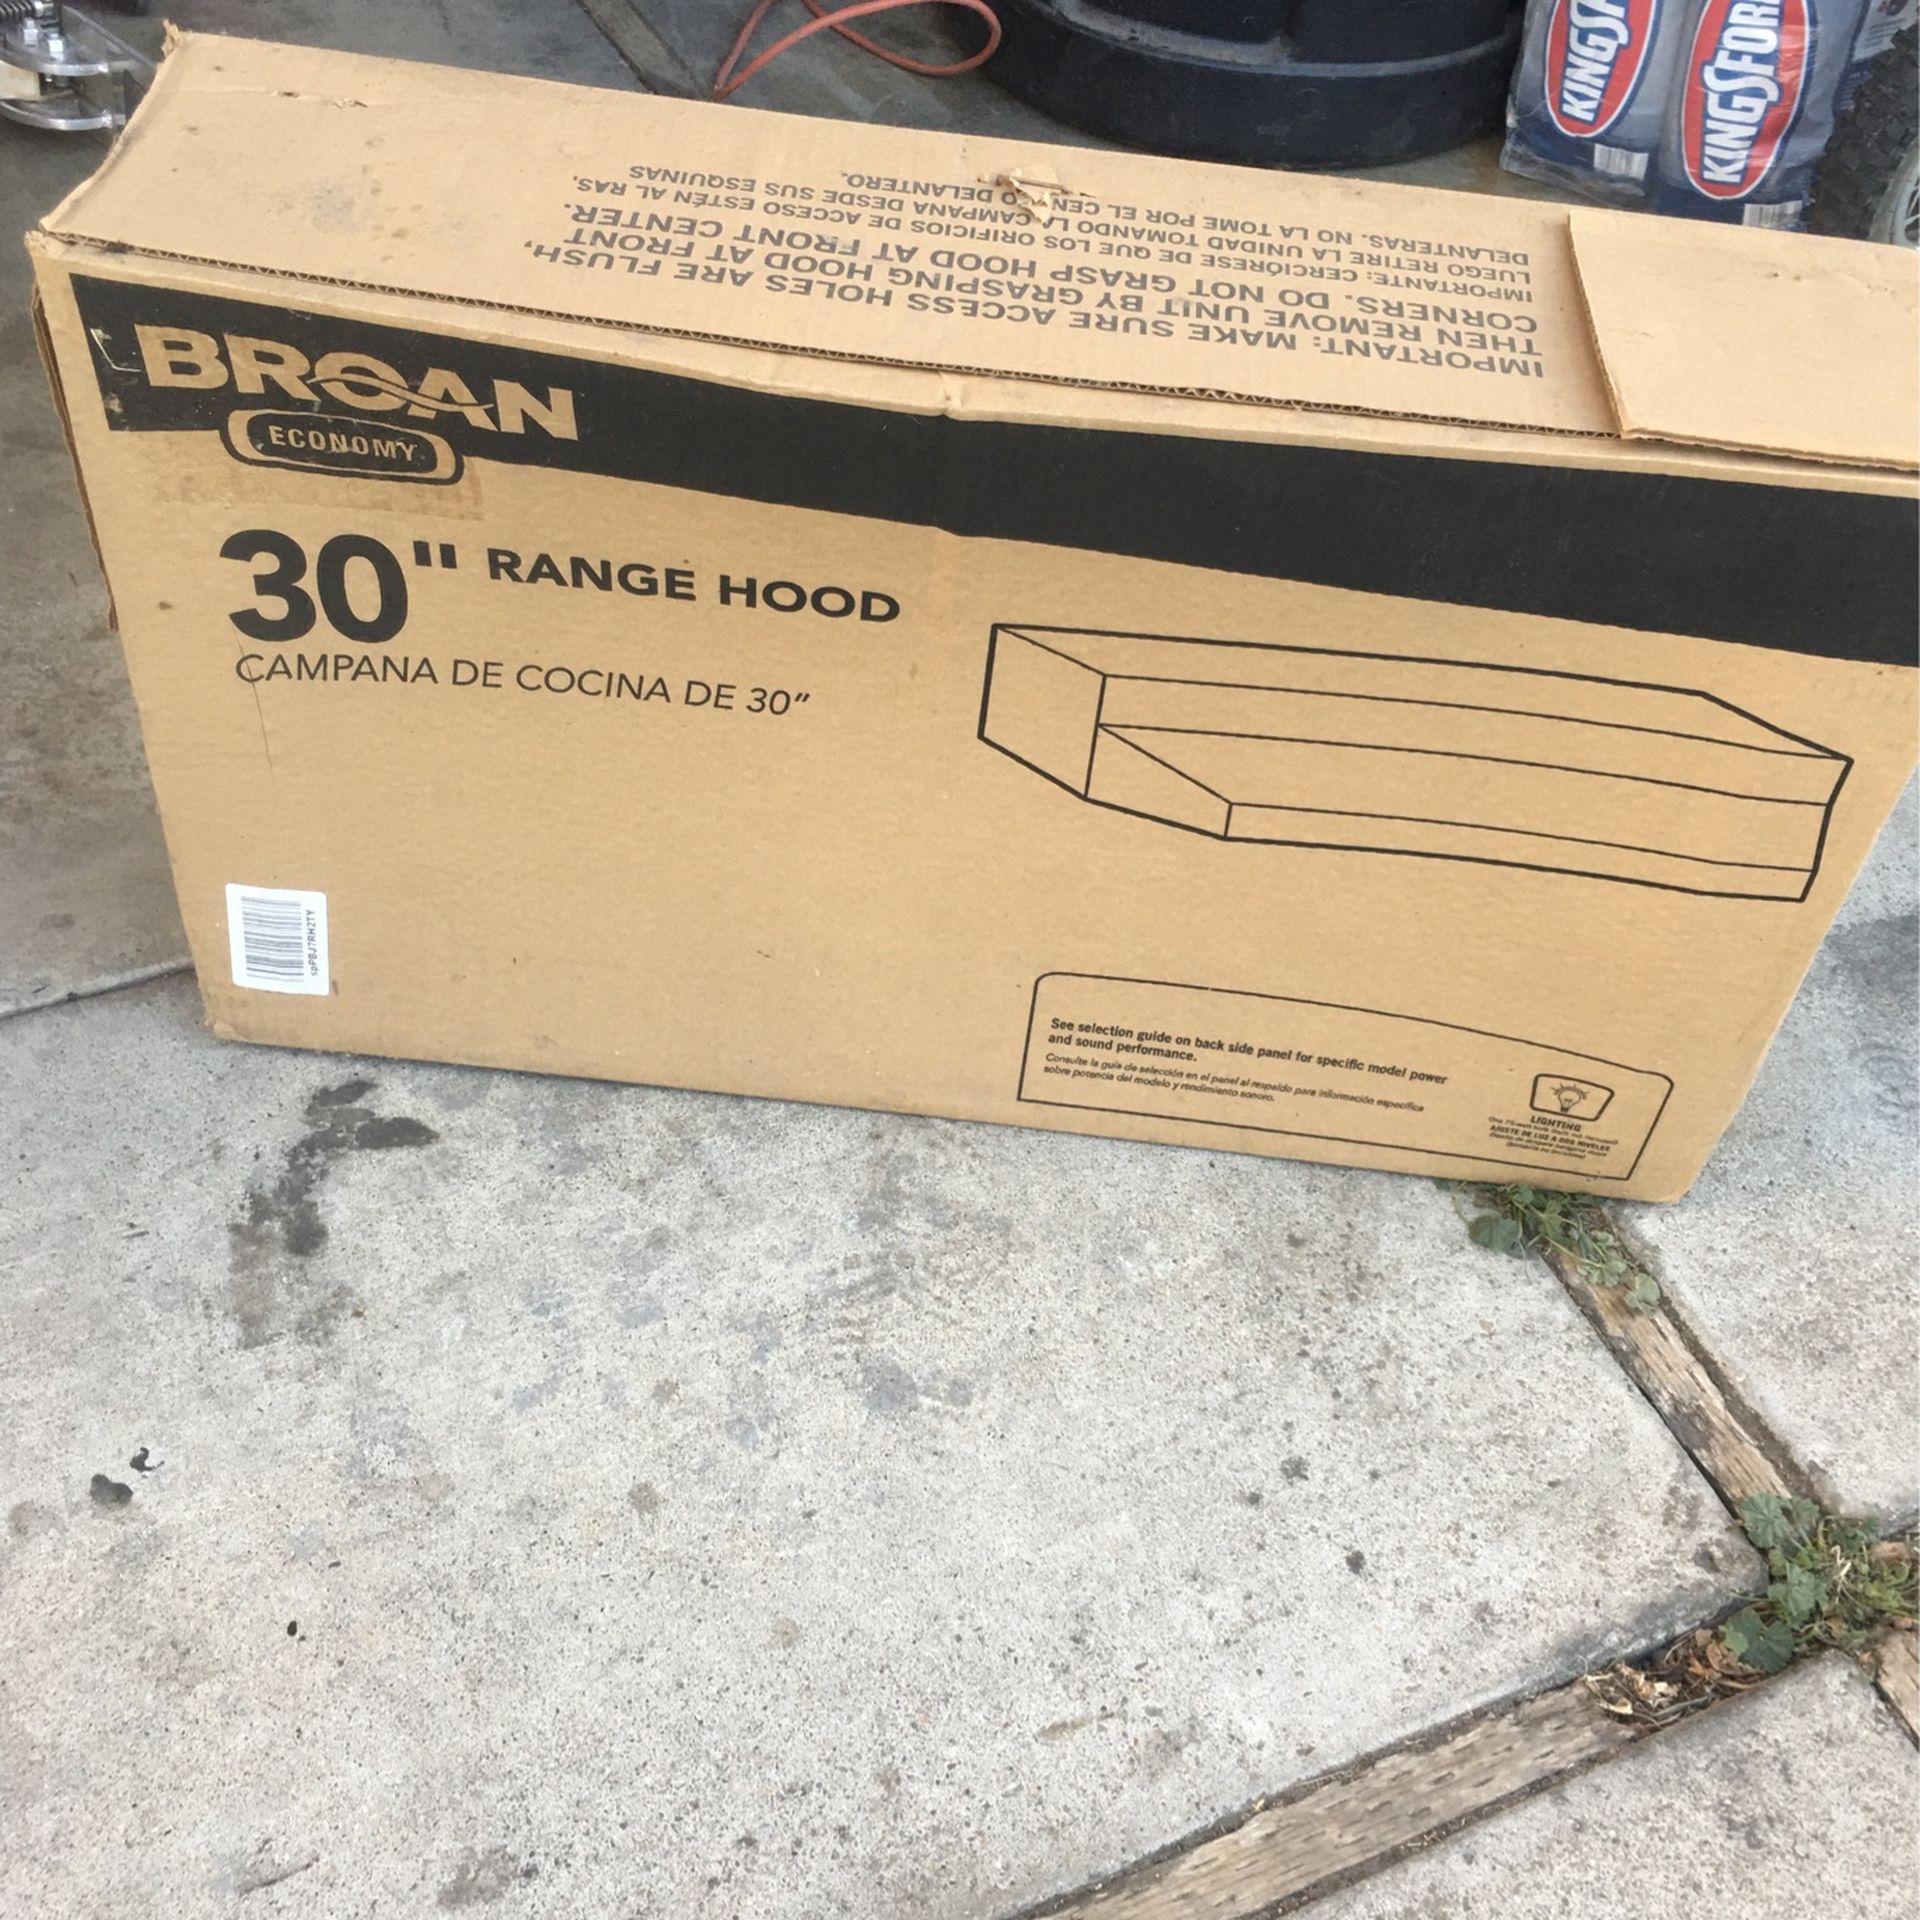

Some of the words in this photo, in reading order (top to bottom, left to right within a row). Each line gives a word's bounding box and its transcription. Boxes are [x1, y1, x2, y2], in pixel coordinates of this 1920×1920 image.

[1702, 0, 1779, 184] KINGSFOR
[572, 176, 628, 196] RAS,
[629, 165, 757, 192] ESQUINAS
[764, 182, 814, 199] SUS
[841, 172, 993, 203] DELANTERO.
[636, 185, 668, 200] AL
[674, 189, 755, 211] ESTÉN
[822, 190, 904, 211] DESDE
[1001, 191, 1100, 215] CENO
[564, 203, 723, 238] CENTER.
[763, 201, 861, 225] ACCESO
[868, 215, 901, 231] DE
[913, 200, 1032, 226] CAMPANA
[1107, 204, 1137, 219] EL
[1146, 210, 1196, 228] POR
[911, 220, 1035, 246] ORIFICIOS
[1078, 219, 1199, 246] TOMANDO
[1203, 216, 1271, 236] TOME
[1279, 225, 1309, 240] LA
[1316, 228, 1352, 245] NO
[563, 228, 695, 258] FRONT
[733, 224, 860, 256] FRONT
[872, 242, 918, 263] AT
[1043, 236, 1091, 253] LOS
[1099, 241, 1151, 260] QUE
[1208, 236, 1303, 259] UNIDAD
[1361, 233, 1529, 266] DELANTERAS.
[524, 240, 661, 275] FLUSH,
[708, 244, 754, 263] AT
[764, 252, 873, 281] HOOD
[929, 249, 1036, 278] HOOD
[1159, 249, 1192, 264] DE
[1312, 248, 1341, 263] LA
[1350, 251, 1438, 273] RETIRE
[674, 262, 754, 287] ARE
[888, 268, 1083, 306] GRASPING
[1049, 264, 1176, 293] GRASP
[1366, 271, 1533, 302] IMPORTANTE:
[1447, 264, 1531, 284] LUEGO
[766, 275, 892, 306] HOLES
[1096, 292, 1143, 312] BY
[1188, 279, 1264, 303] NOT
[1278, 289, 1329, 309] DO
[907, 293, 1056, 325] ACCESS
[1157, 298, 1249, 324] UNIT
[1344, 293, 1538, 333] CORNERS.
[1068, 311, 1175, 337] SURE
[1188, 324, 1296, 349] MAKE
[1263, 309, 1420, 340] REMOVE
[1437, 328, 1542, 357] THEN
[1313, 336, 1544, 378] IMPORTANT:
[133, 323, 578, 441] BROAN
[269, 425, 418, 463] ECONOMY
[219, 528, 457, 643] 30"
[487, 548, 697, 601] RANGE
[719, 574, 901, 623] HOOD
[235, 653, 438, 684] CAMPANA
[452, 659, 503, 688] DE
[516, 664, 671, 702] COCINA
[684, 681, 735, 710] DE
[1048, 1033, 1072, 1046] and
[1075, 1036, 1113, 1051] sound
[1116, 1041, 1197, 1062] performance.
[1051, 1017, 1075, 1031] See
[1077, 1023, 1133, 1038] selection
[1136, 1030, 1172, 1044] guide
[1175, 1036, 1191, 1046] on
[1194, 1037, 1224, 1051] back
[1228, 1043, 1254, 1055] side
[1257, 1046, 1292, 1060] panel
[1295, 1051, 1313, 1063] for
[1316, 1055, 1365, 1071] specific
[1368, 1063, 1407, 1078] model
[1409, 1071, 1448, 1085] power
[1530, 1115, 1582, 1132] LIGHTING
